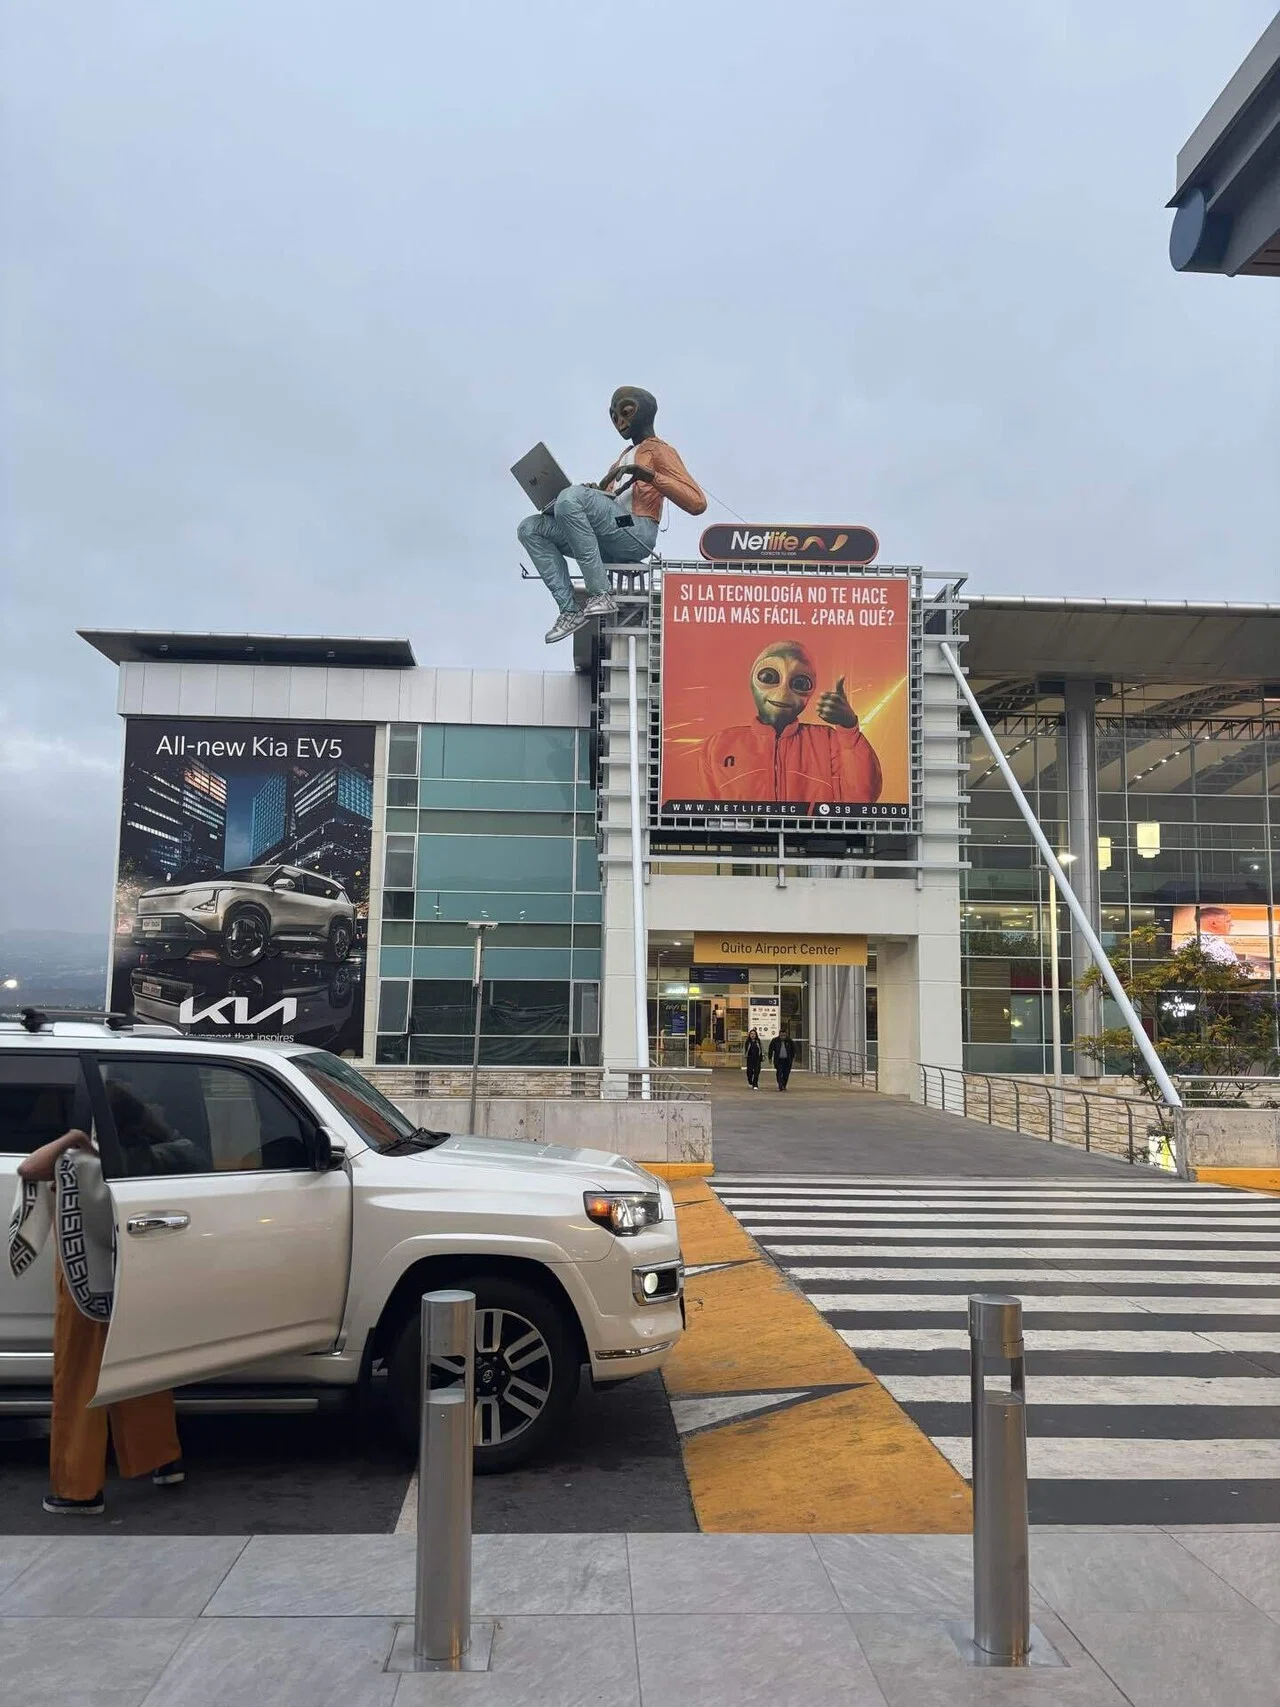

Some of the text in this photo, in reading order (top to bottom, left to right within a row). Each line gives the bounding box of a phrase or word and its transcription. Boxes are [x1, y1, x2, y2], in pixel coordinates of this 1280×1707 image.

[731, 531, 799, 551] Netlife
[680, 583, 888, 604] SI LA TECNOLOGÍA NO TE HACE
[674, 604, 895, 627] LA VIDA MÁS FÁCIL. ¿PARA QUÉ?
[156, 735, 342, 759] All-new Kia EV5
[835, 805, 851, 814] 39
[862, 806, 907, 815] 20000
[721, 941, 841, 956] Quito Airport Center
[257, 1032, 295, 1043] inspires
